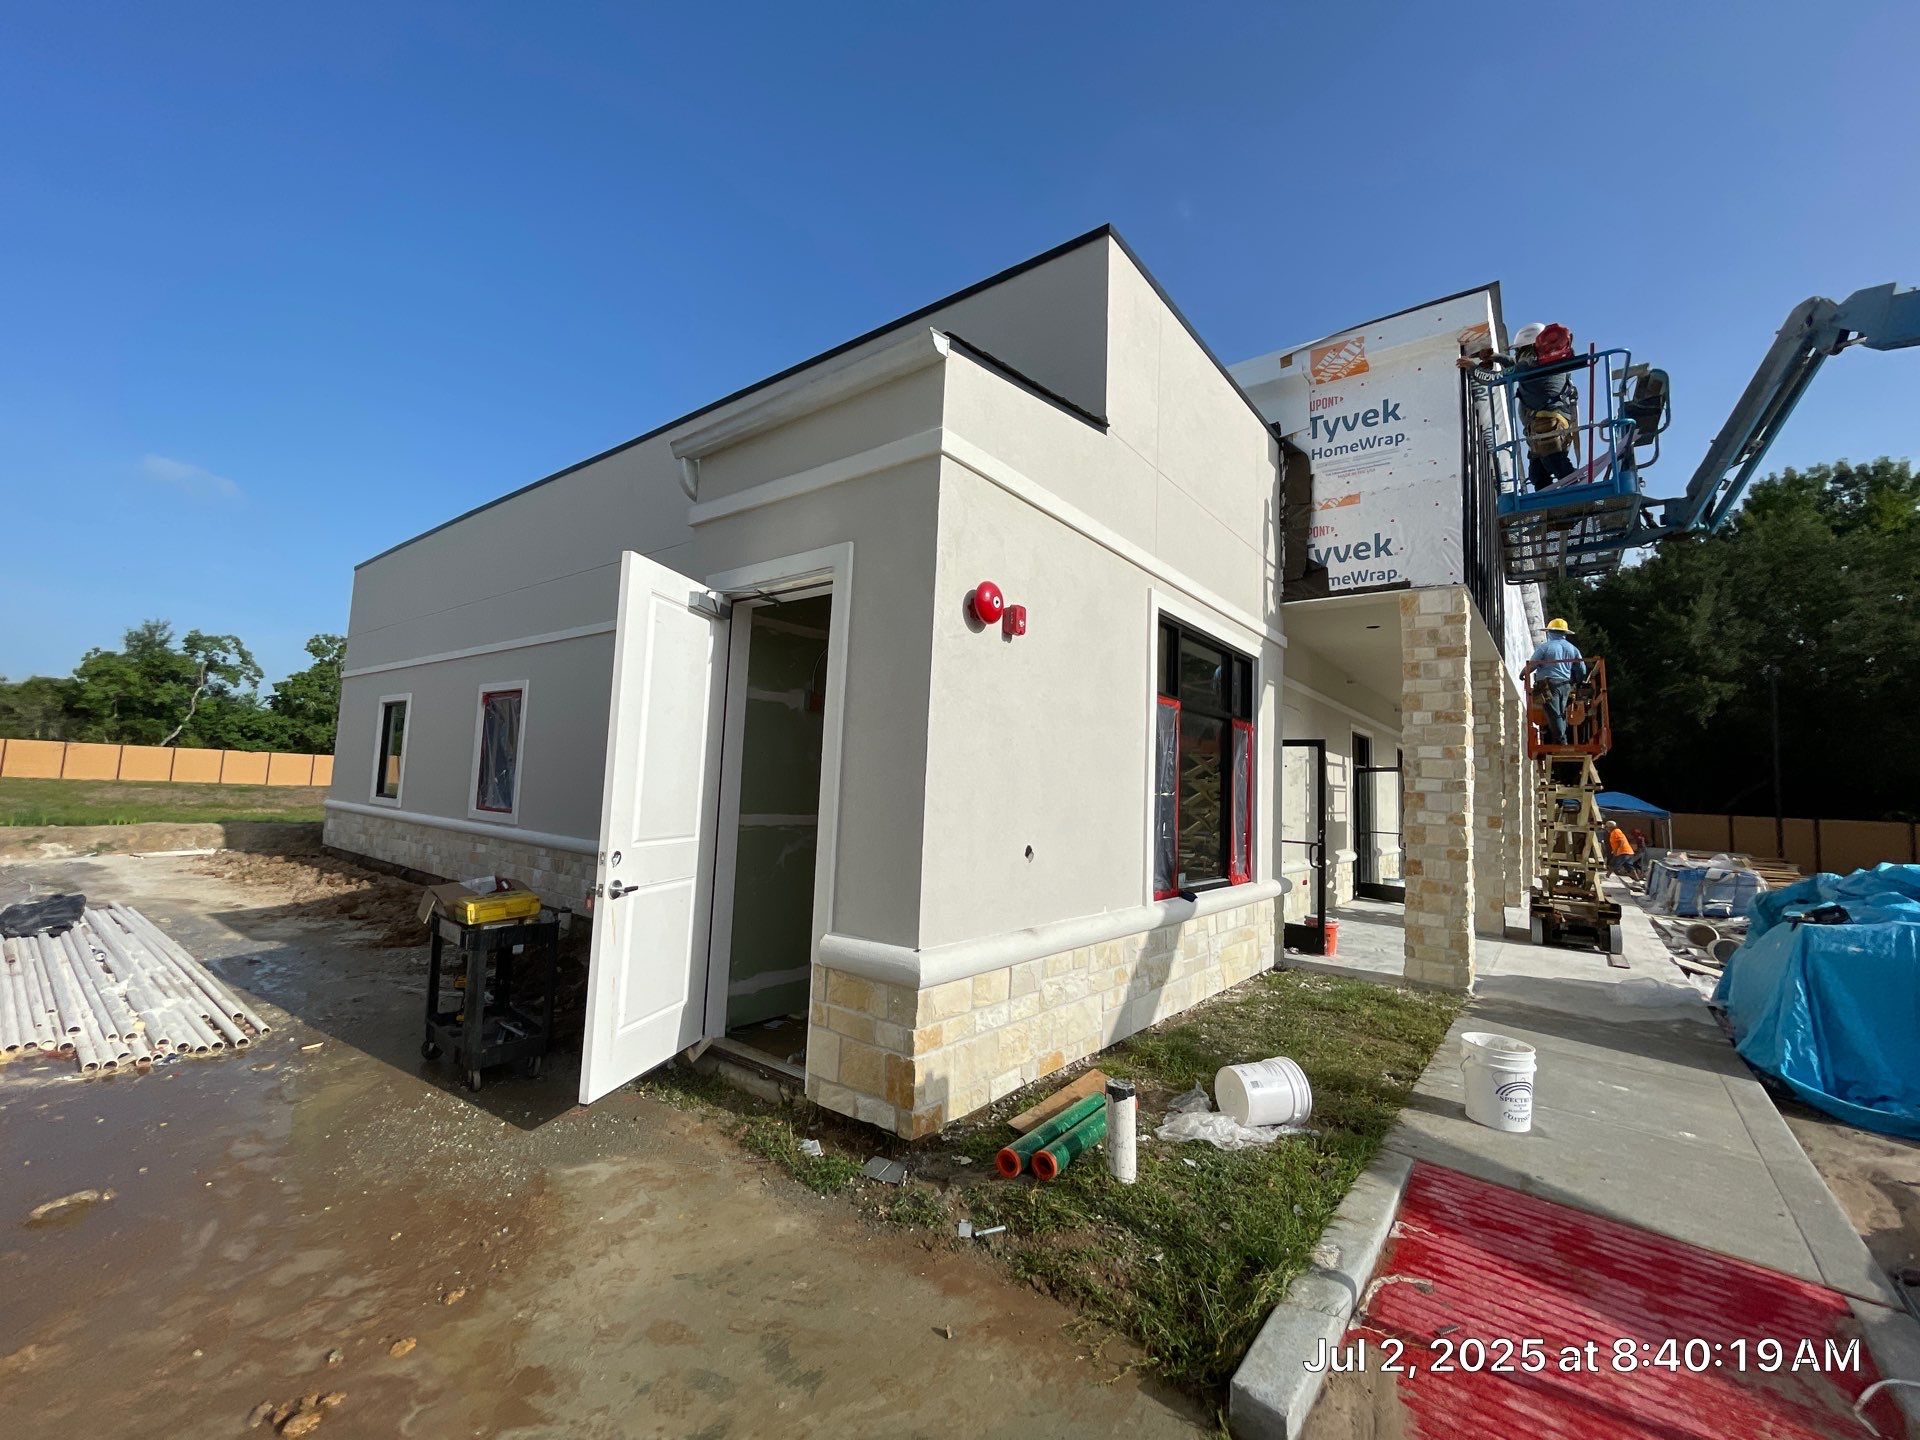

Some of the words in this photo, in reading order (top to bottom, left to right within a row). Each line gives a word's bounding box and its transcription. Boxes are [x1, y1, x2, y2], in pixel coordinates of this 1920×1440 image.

[1310, 396, 1339, 411] UPONT
[1310, 398, 1401, 443] Tyvek
[1311, 433, 1405, 460] HomeWrap
[1308, 525, 1330, 540] PONT
[1328, 569, 1398, 587] meWrap
